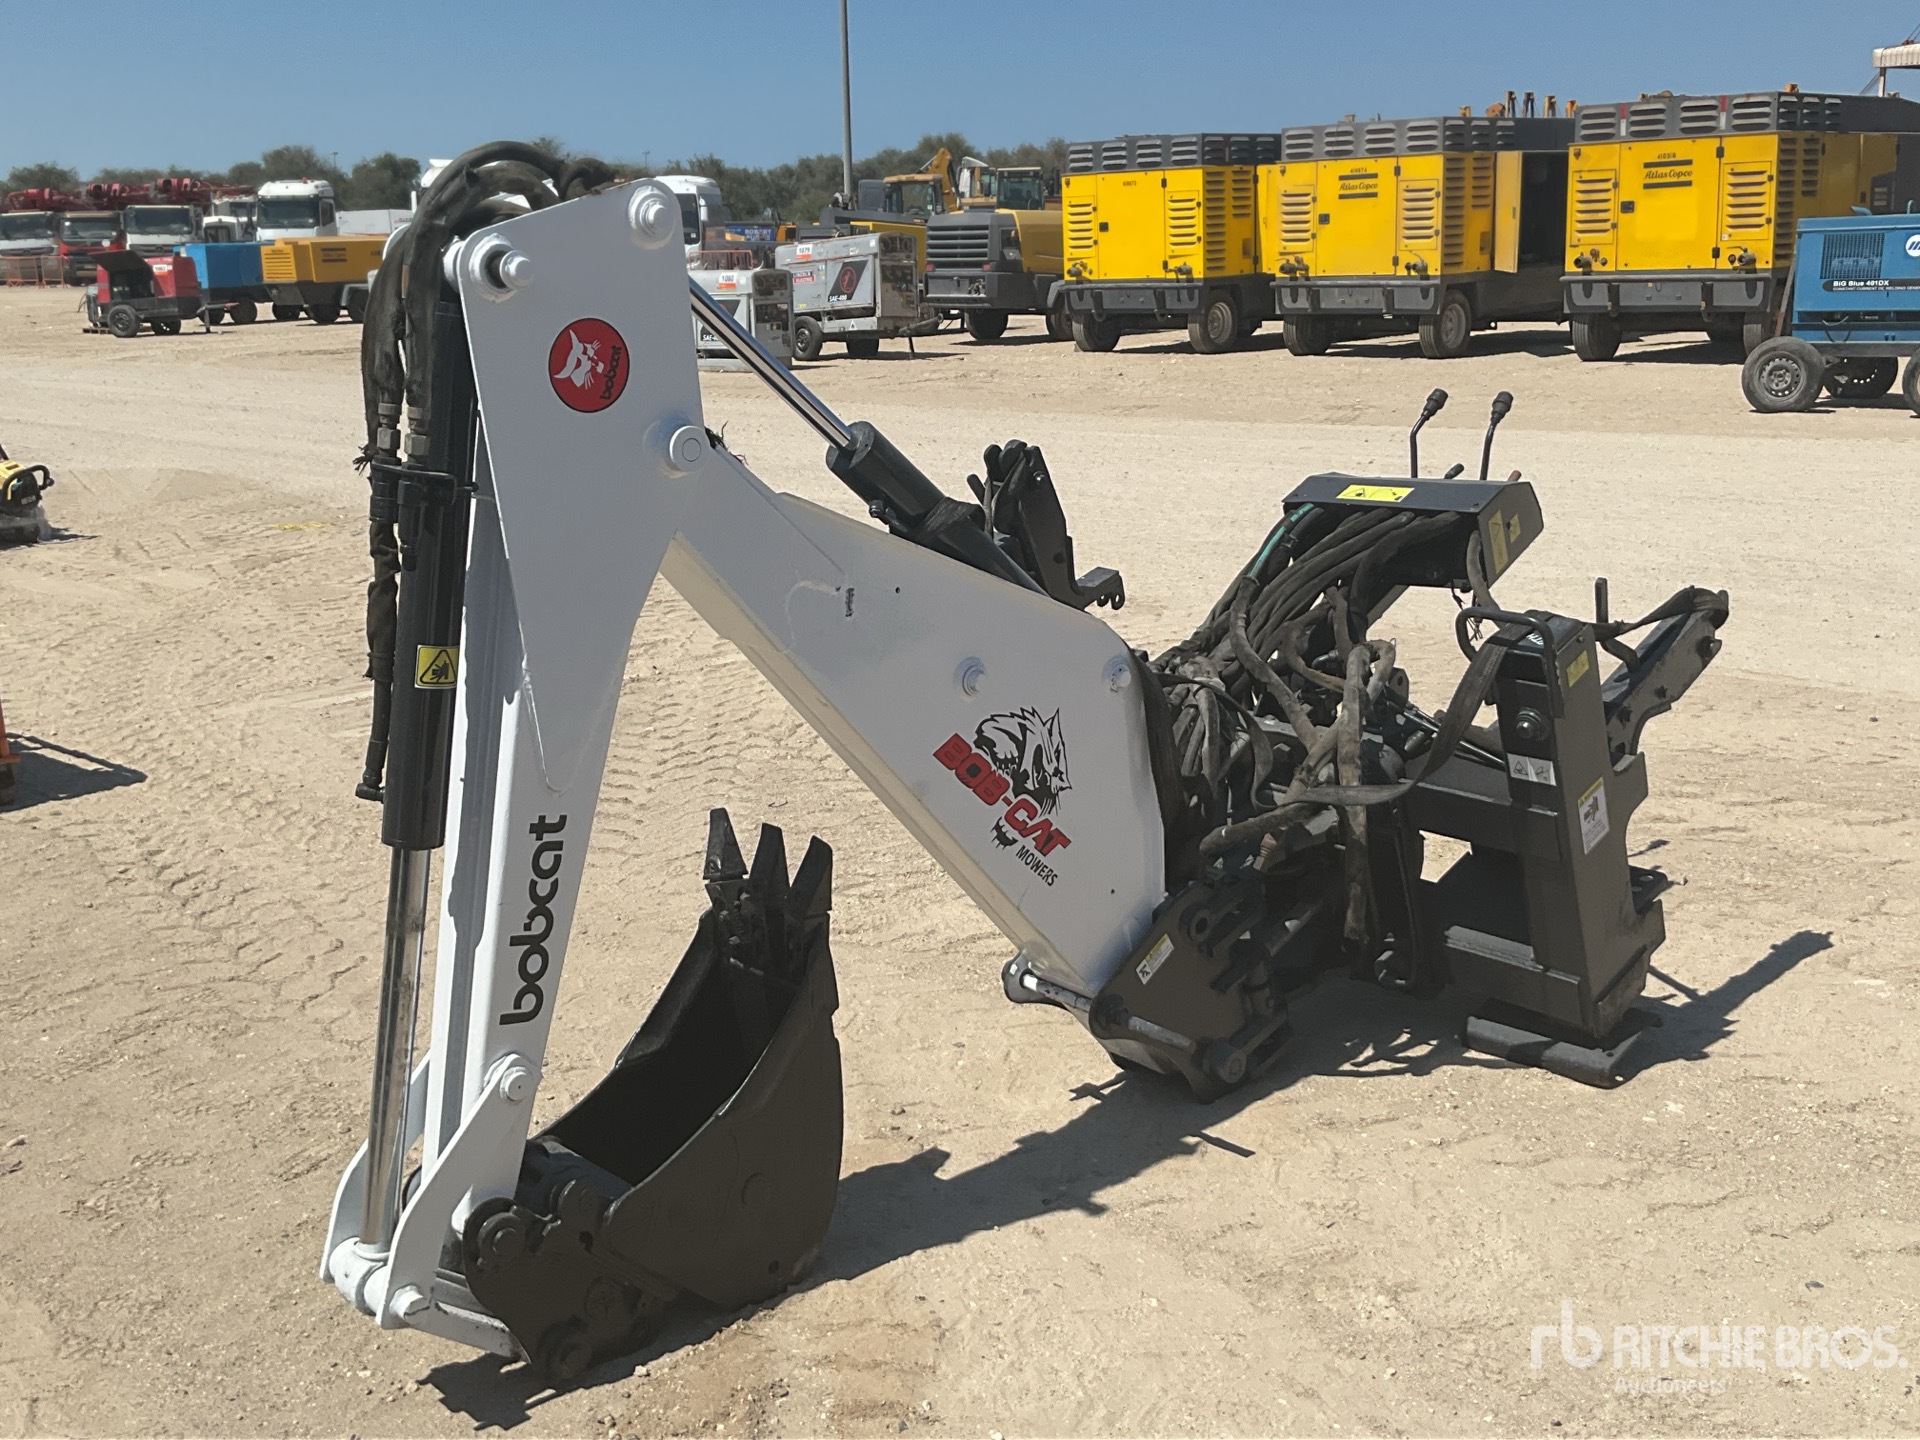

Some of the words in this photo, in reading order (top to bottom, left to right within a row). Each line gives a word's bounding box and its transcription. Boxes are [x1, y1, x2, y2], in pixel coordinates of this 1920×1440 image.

[1340, 182, 1358, 190] Atlas
[1359, 182, 1378, 190] Copco
[1644, 170, 1668, 179] Atlas
[1669, 169, 1692, 179] Copco
[600, 345, 622, 400] bobcat
[933, 733, 1072, 857] BOB-CAT
[1015, 844, 1059, 886] MOWERS
[499, 813, 568, 1026] bobcat
